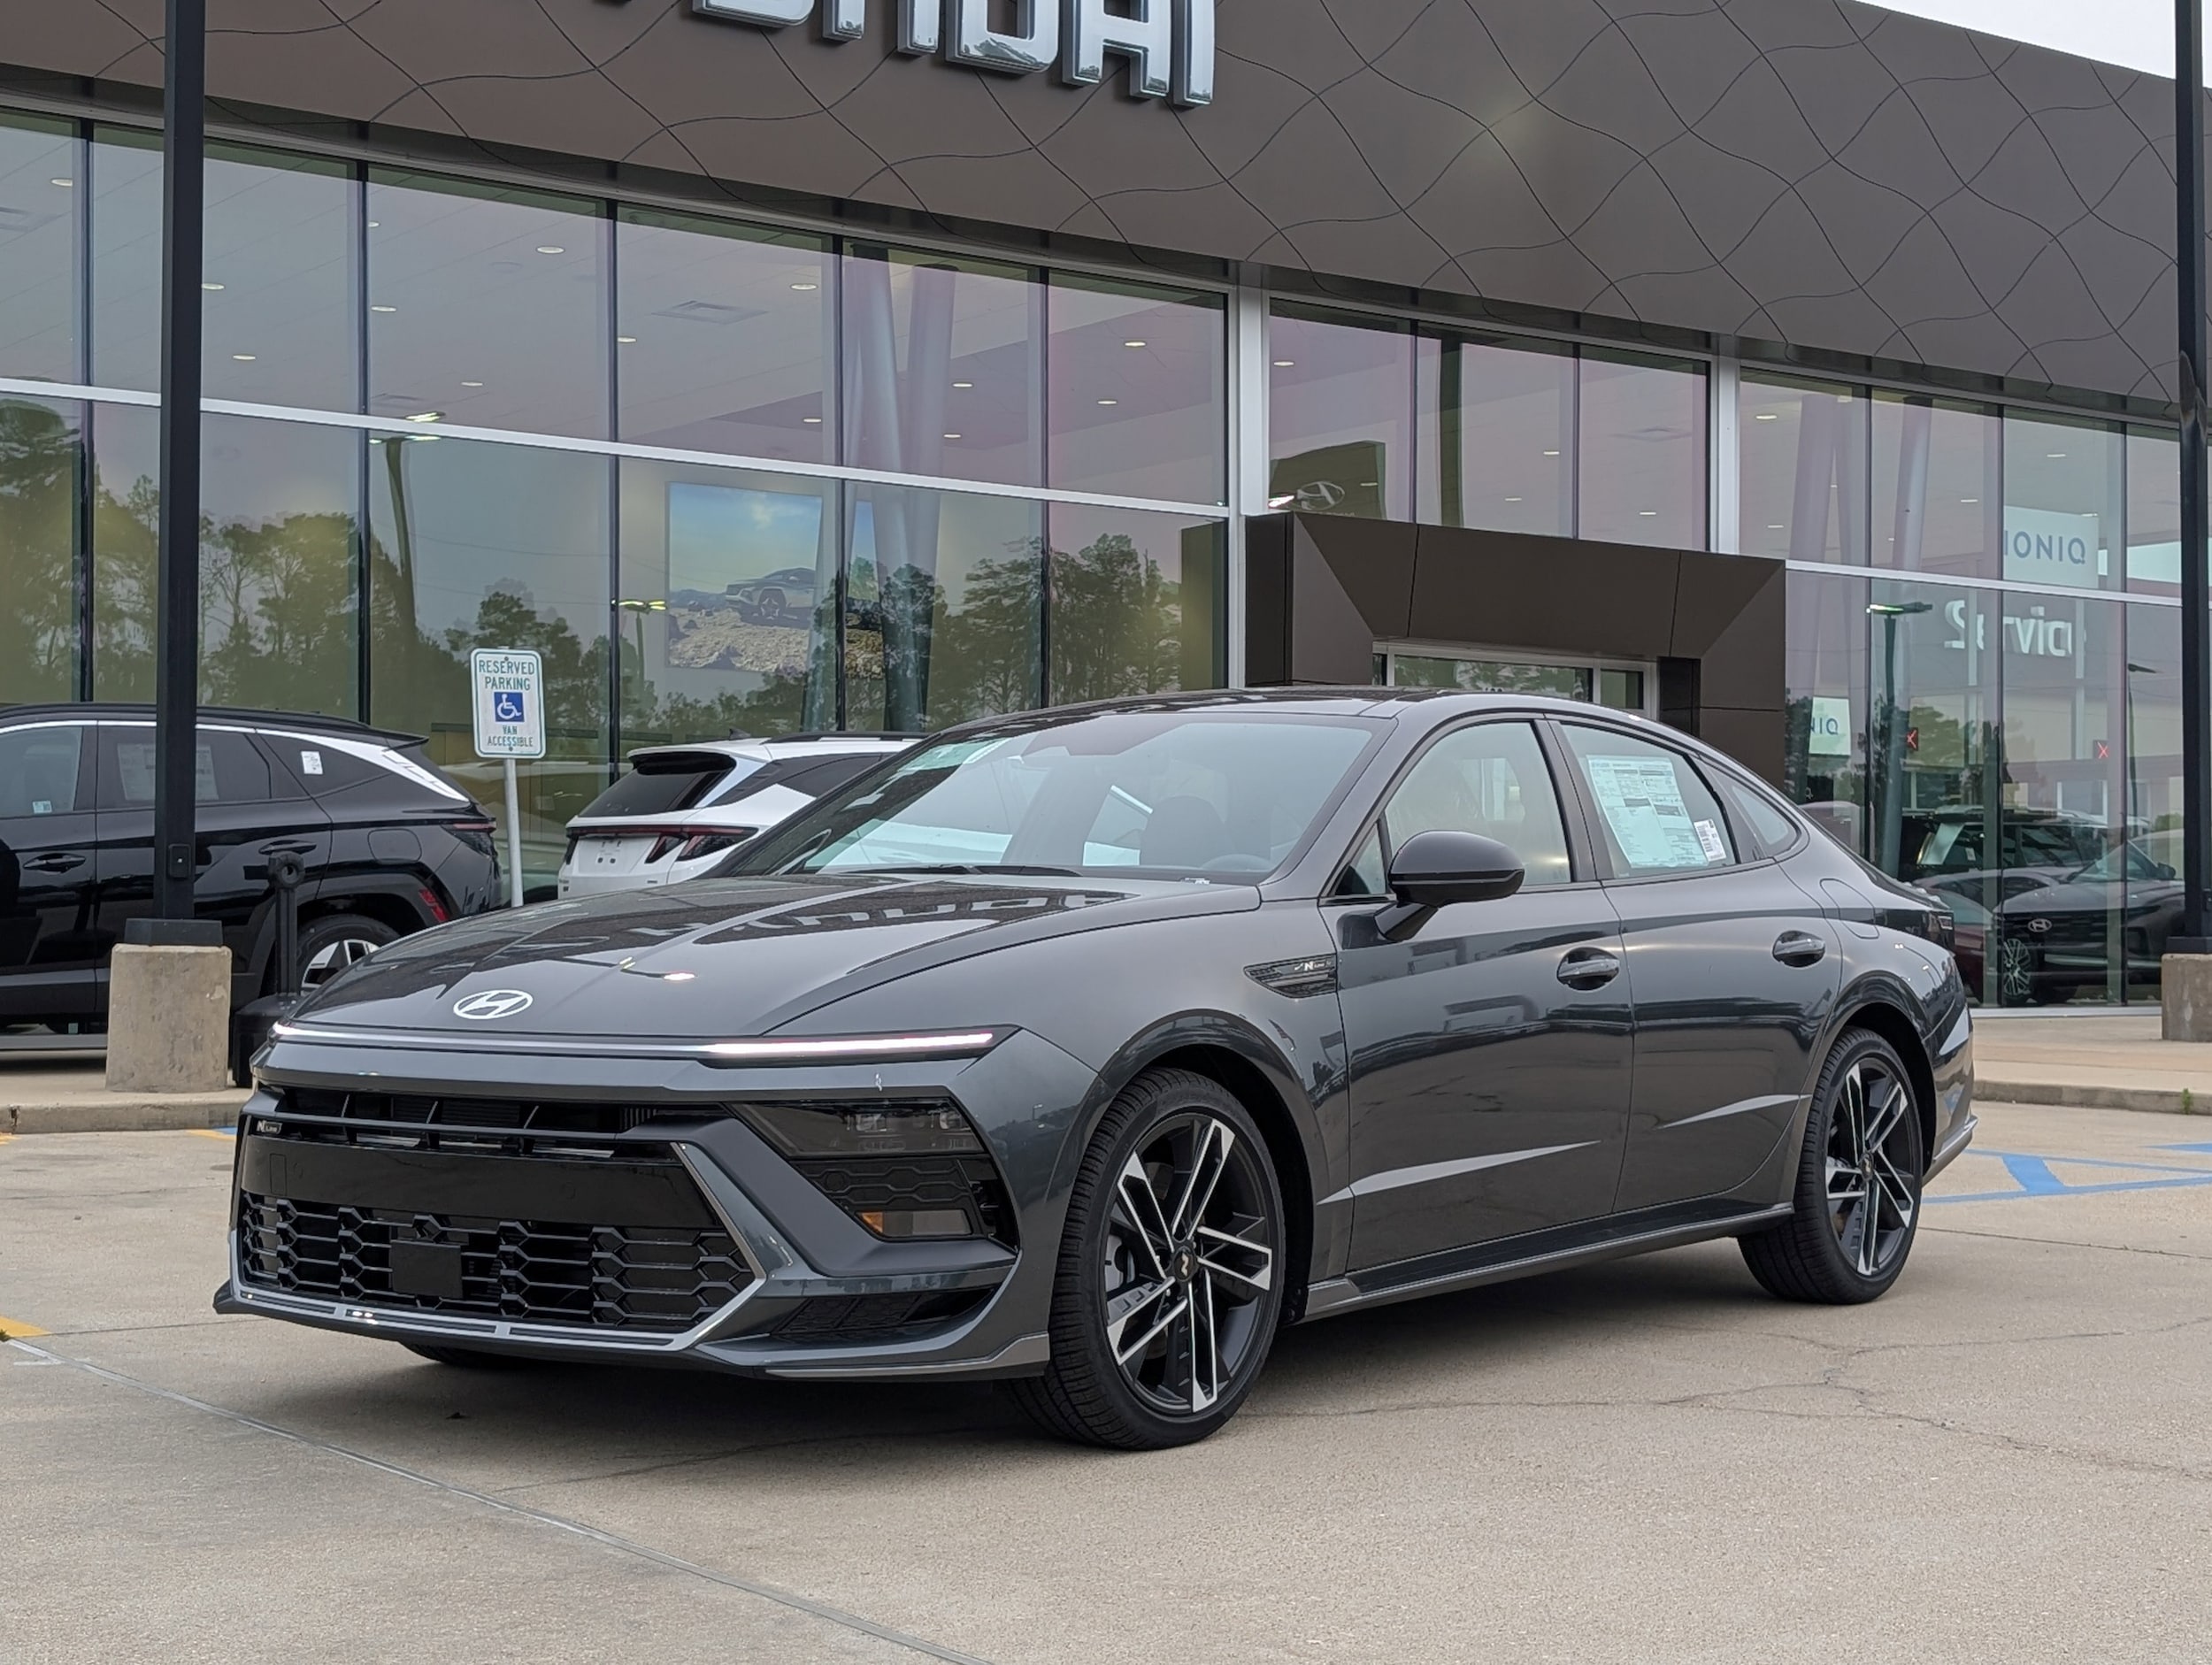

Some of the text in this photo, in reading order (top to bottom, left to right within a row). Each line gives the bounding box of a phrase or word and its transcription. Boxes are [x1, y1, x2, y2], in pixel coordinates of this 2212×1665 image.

[2004, 530, 2086, 564] IONIQ
[479, 660, 535, 675] RESERVED
[484, 676, 531, 691] PARKING
[502, 725, 518, 735] VAN
[487, 736, 534, 748] ACCESSIBLE
